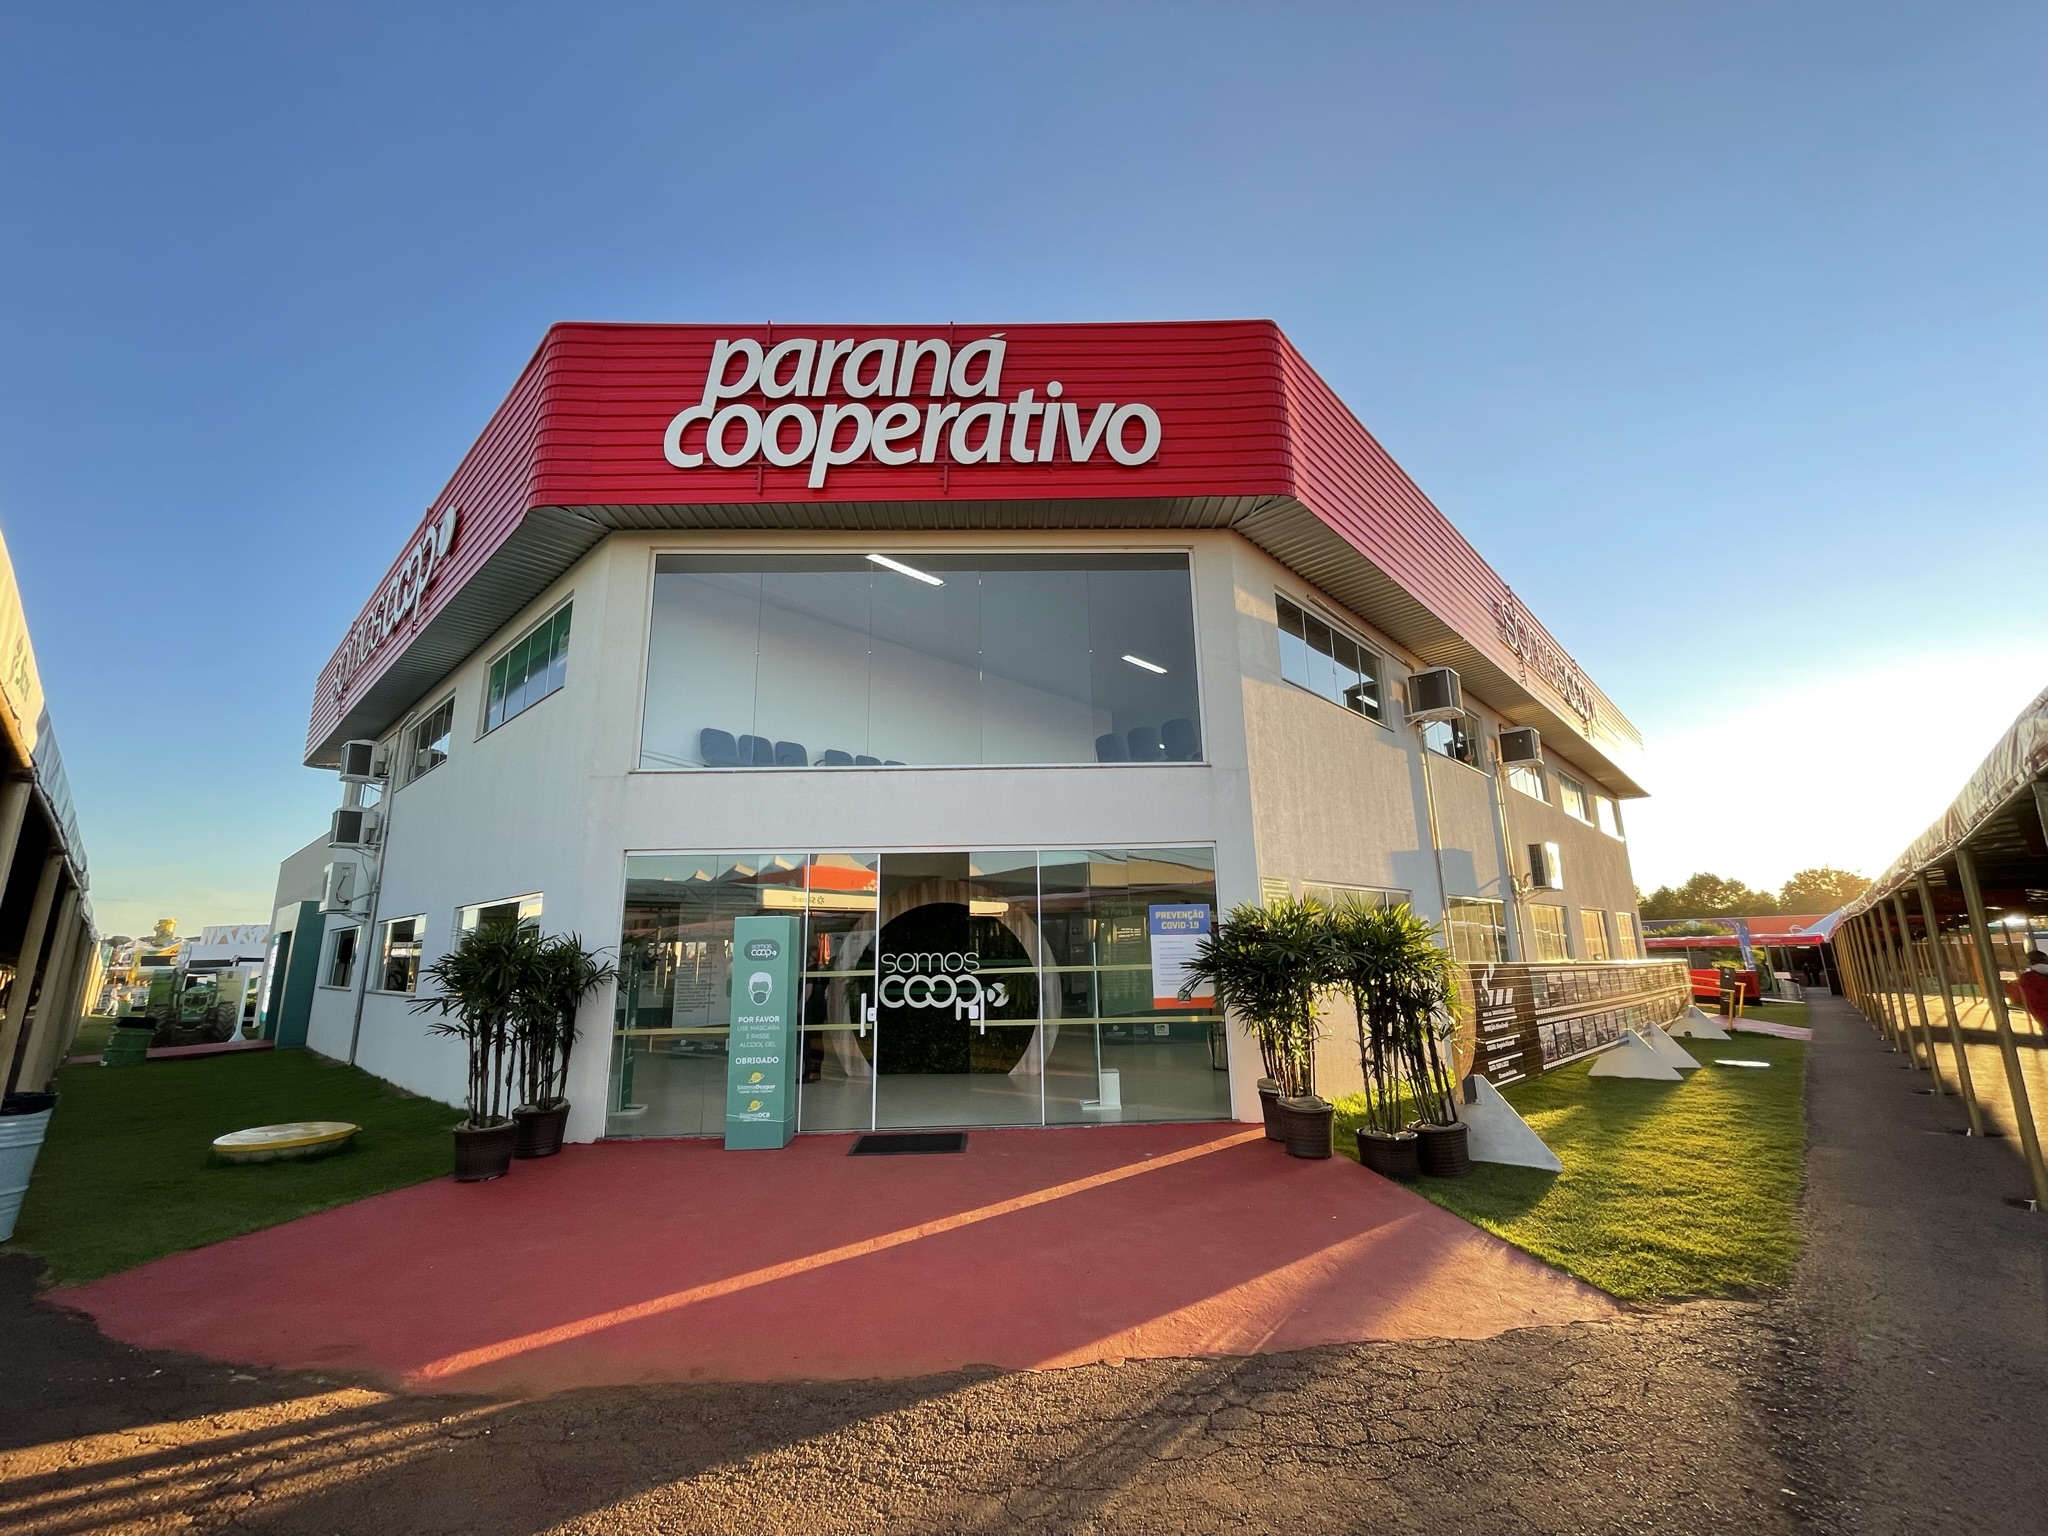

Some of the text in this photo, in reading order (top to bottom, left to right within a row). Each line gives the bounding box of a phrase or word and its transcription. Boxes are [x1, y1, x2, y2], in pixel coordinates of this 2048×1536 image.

[703, 332, 1007, 412] paraná
[663, 380, 1163, 489] cooperativo
[1155, 909, 1204, 920] PREVENÇÃO
[1161, 920, 1199, 929] COVID-19
[880, 952, 980, 974] somos
[879, 974, 983, 1021] coop
[755, 1015, 780, 1023] FAVOR
[735, 1056, 779, 1065] OBRIGADO
